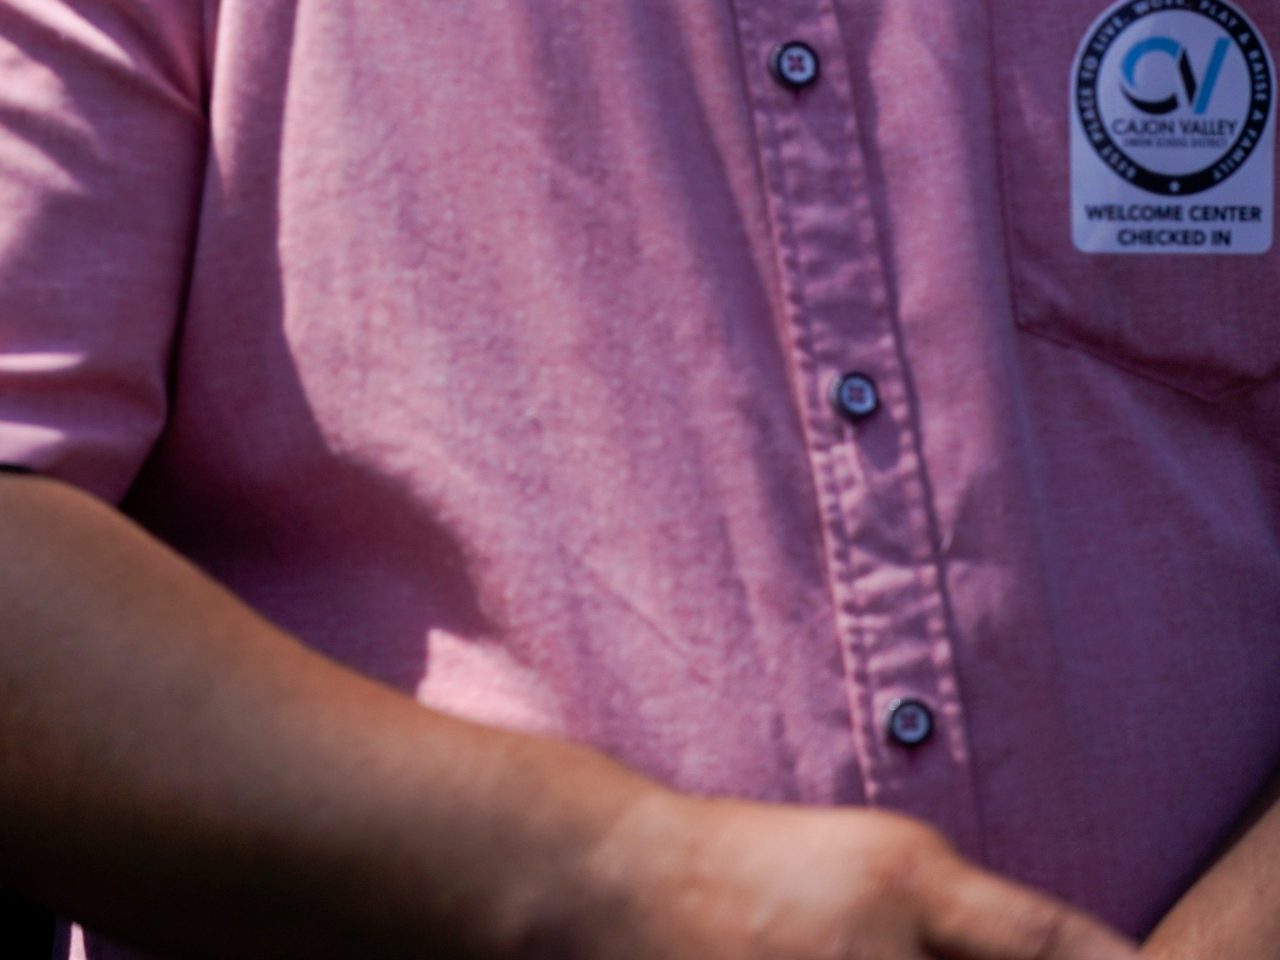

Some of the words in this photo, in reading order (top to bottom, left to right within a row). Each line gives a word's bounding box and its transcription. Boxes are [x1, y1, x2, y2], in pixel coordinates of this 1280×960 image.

[1080, 55, 1098, 79] TO
[1247, 49, 1269, 102] RAISE
[1079, 86, 1103, 143] PLACE
[1251, 110, 1265, 121] A
[1112, 119, 1174, 135] CAJON
[1179, 119, 1237, 135] VALLEY
[1212, 128, 1258, 181] FAMILY
[1085, 205, 1183, 222] WELCOME
[1188, 205, 1262, 222] CENTER
[1117, 230, 1207, 246] CHECKED
[1211, 230, 1232, 246] IN
